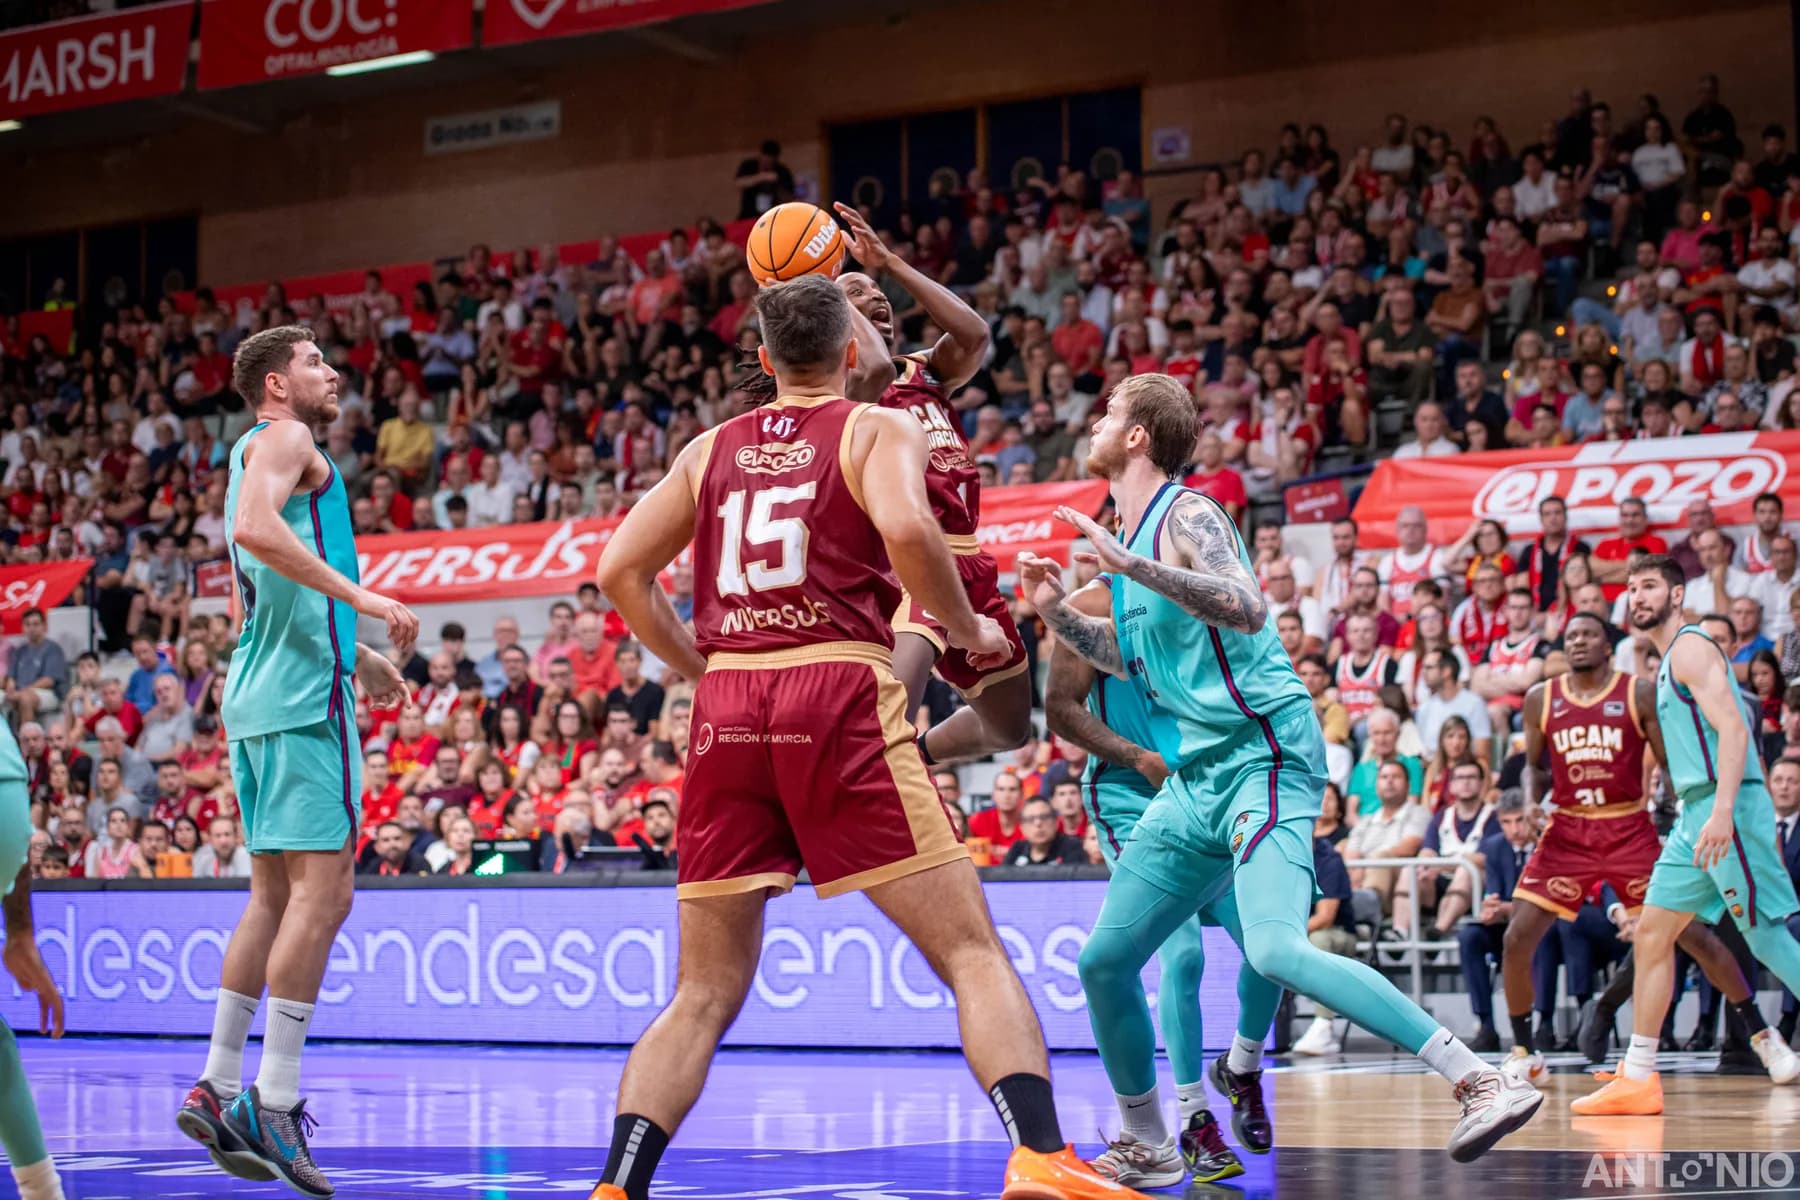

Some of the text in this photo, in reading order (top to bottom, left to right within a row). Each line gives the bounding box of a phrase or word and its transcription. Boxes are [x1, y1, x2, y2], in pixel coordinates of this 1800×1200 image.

[927, 429, 964, 452] URCIA
[716, 480, 817, 599] 15
[771, 734, 812, 744] MURCIA
[1552, 724, 1622, 754] UCAM
[1565, 747, 1613, 766] MURCIA
[10, 903, 232, 1001] desa
[318, 902, 667, 1008] endesa
